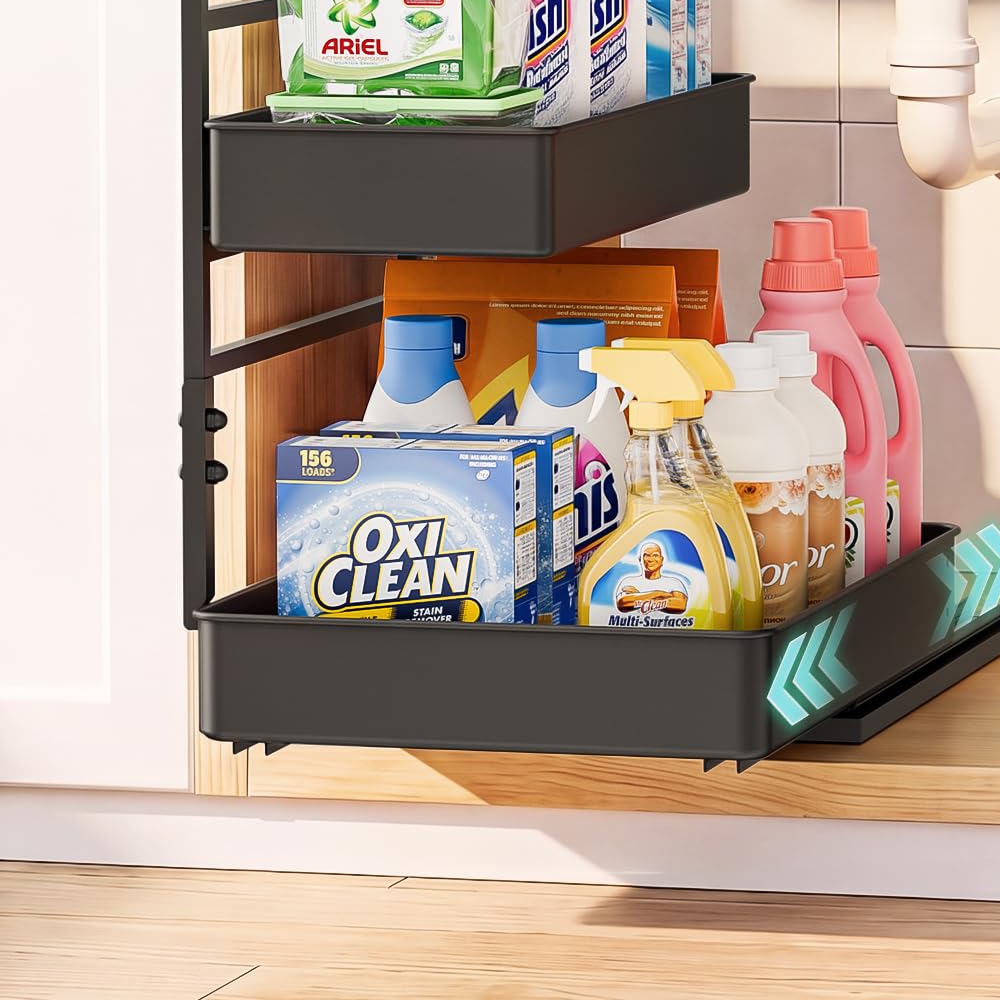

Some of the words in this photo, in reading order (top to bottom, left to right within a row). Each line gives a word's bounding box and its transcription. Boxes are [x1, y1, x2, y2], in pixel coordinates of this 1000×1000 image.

[300, 449, 333, 467] 156
[351, 515, 443, 564] OXI
[316, 554, 472, 608] CLEAN
[413, 606, 443, 617] STAIN
[608, 615, 694, 627] Multi-Surfaces
